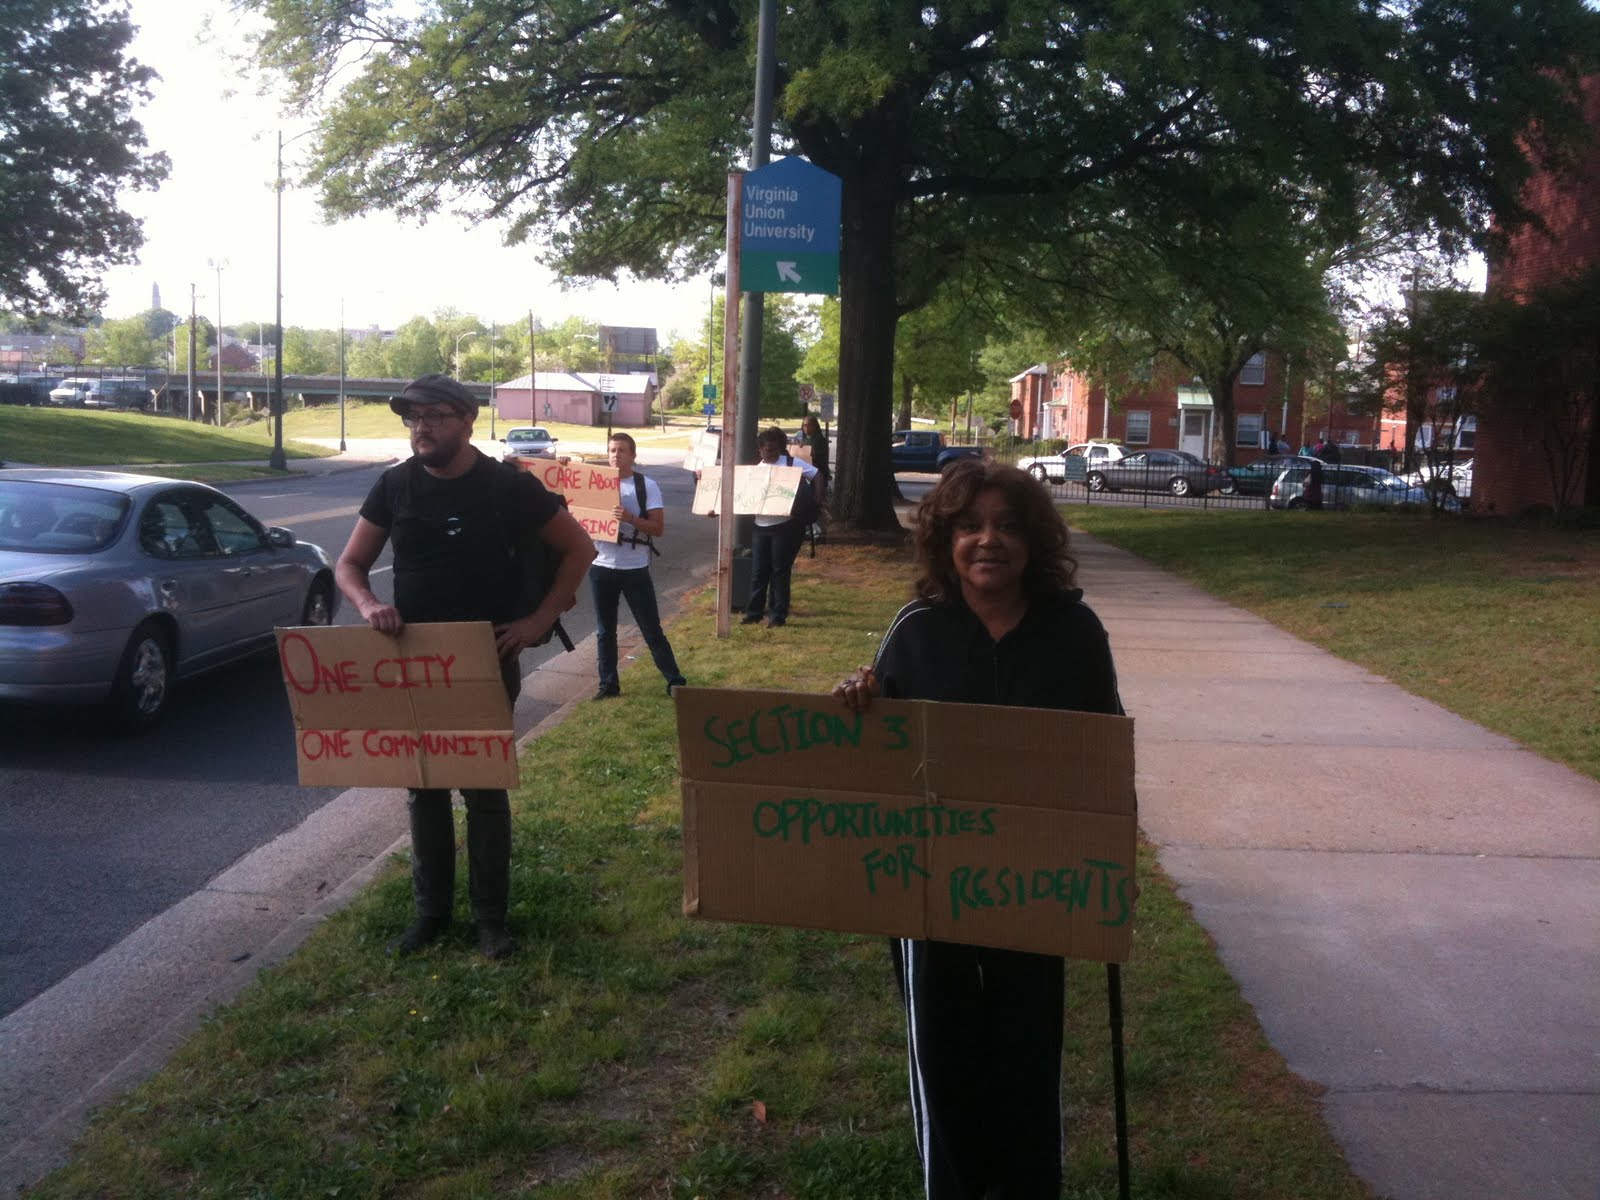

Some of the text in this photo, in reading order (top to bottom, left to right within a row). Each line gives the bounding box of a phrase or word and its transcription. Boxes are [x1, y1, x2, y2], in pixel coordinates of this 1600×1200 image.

[746, 185, 798, 204] Virginia
[745, 203, 785, 220] Union
[744, 221, 815, 242] University
[544, 466, 582, 490] CARE
[588, 469, 621, 491] ABOUT
[578, 518, 618, 537] SING
[280, 631, 457, 695] ONE CITY
[301, 729, 514, 763] ONE COMMUNITY
[703, 703, 911, 769] SECTION 3
[752, 797, 1000, 845] OPPORTUNITIES
[861, 843, 1132, 929] FOR RESIDENTS
